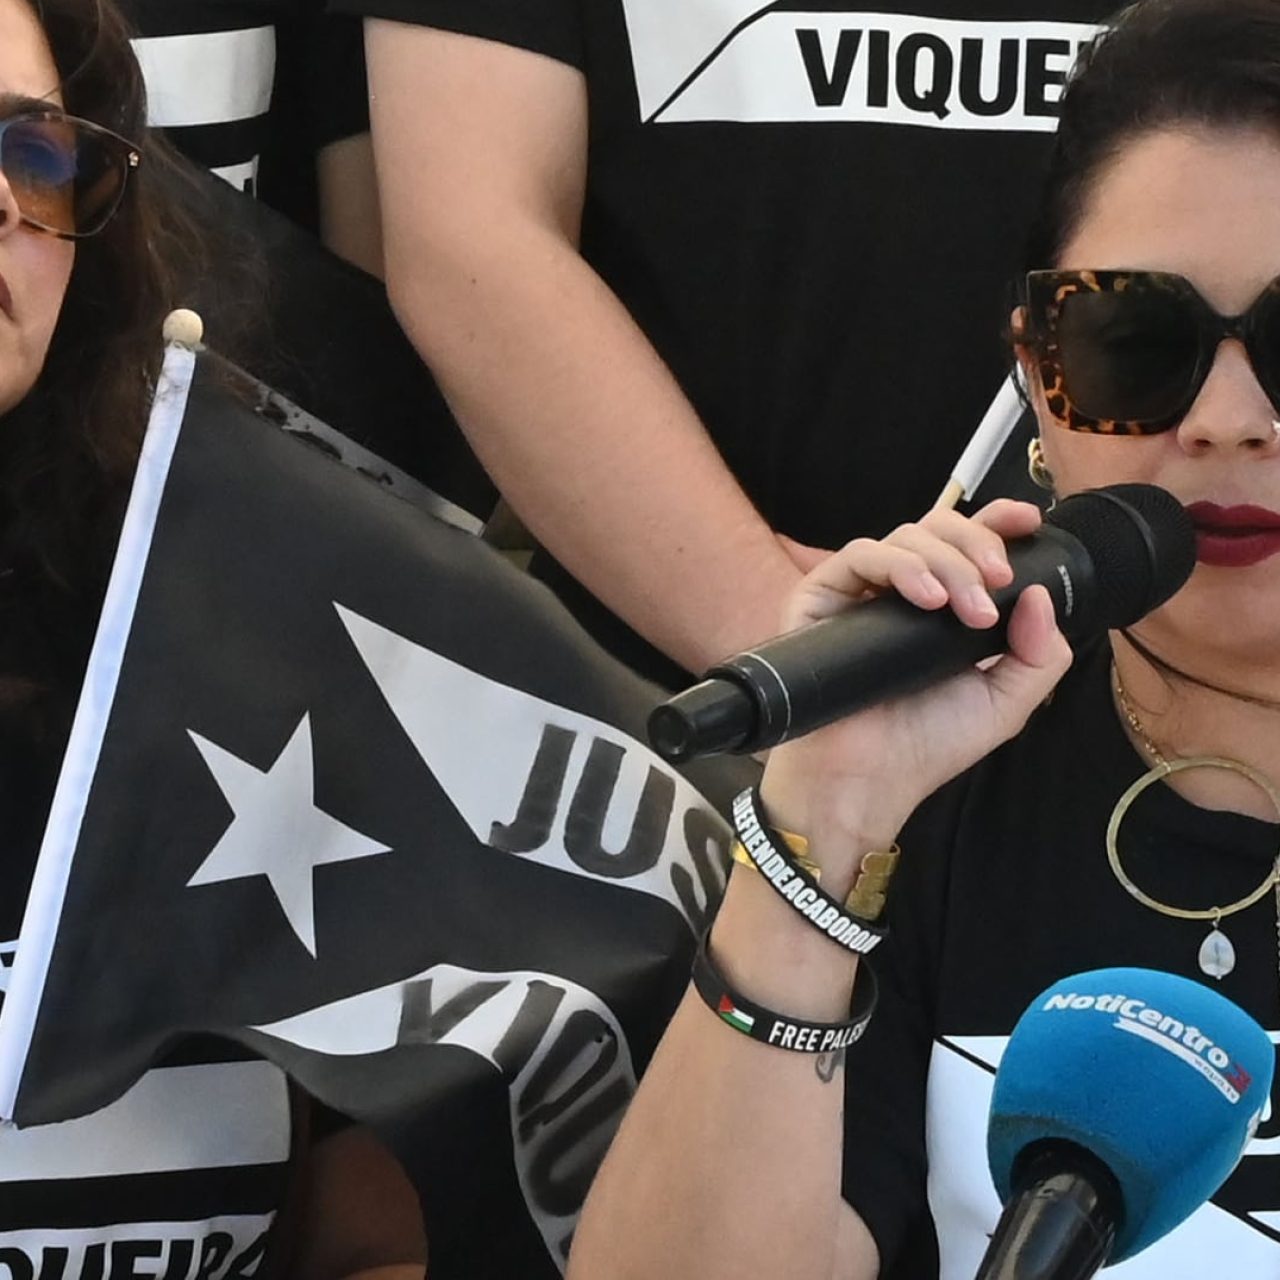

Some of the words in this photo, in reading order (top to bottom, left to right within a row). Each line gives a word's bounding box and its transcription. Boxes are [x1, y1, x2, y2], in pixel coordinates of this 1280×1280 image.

[796, 28, 1092, 120] VIQUE
[768, 1021, 821, 1051] FREE
[1042, 993, 1229, 1068] NotiCentro
